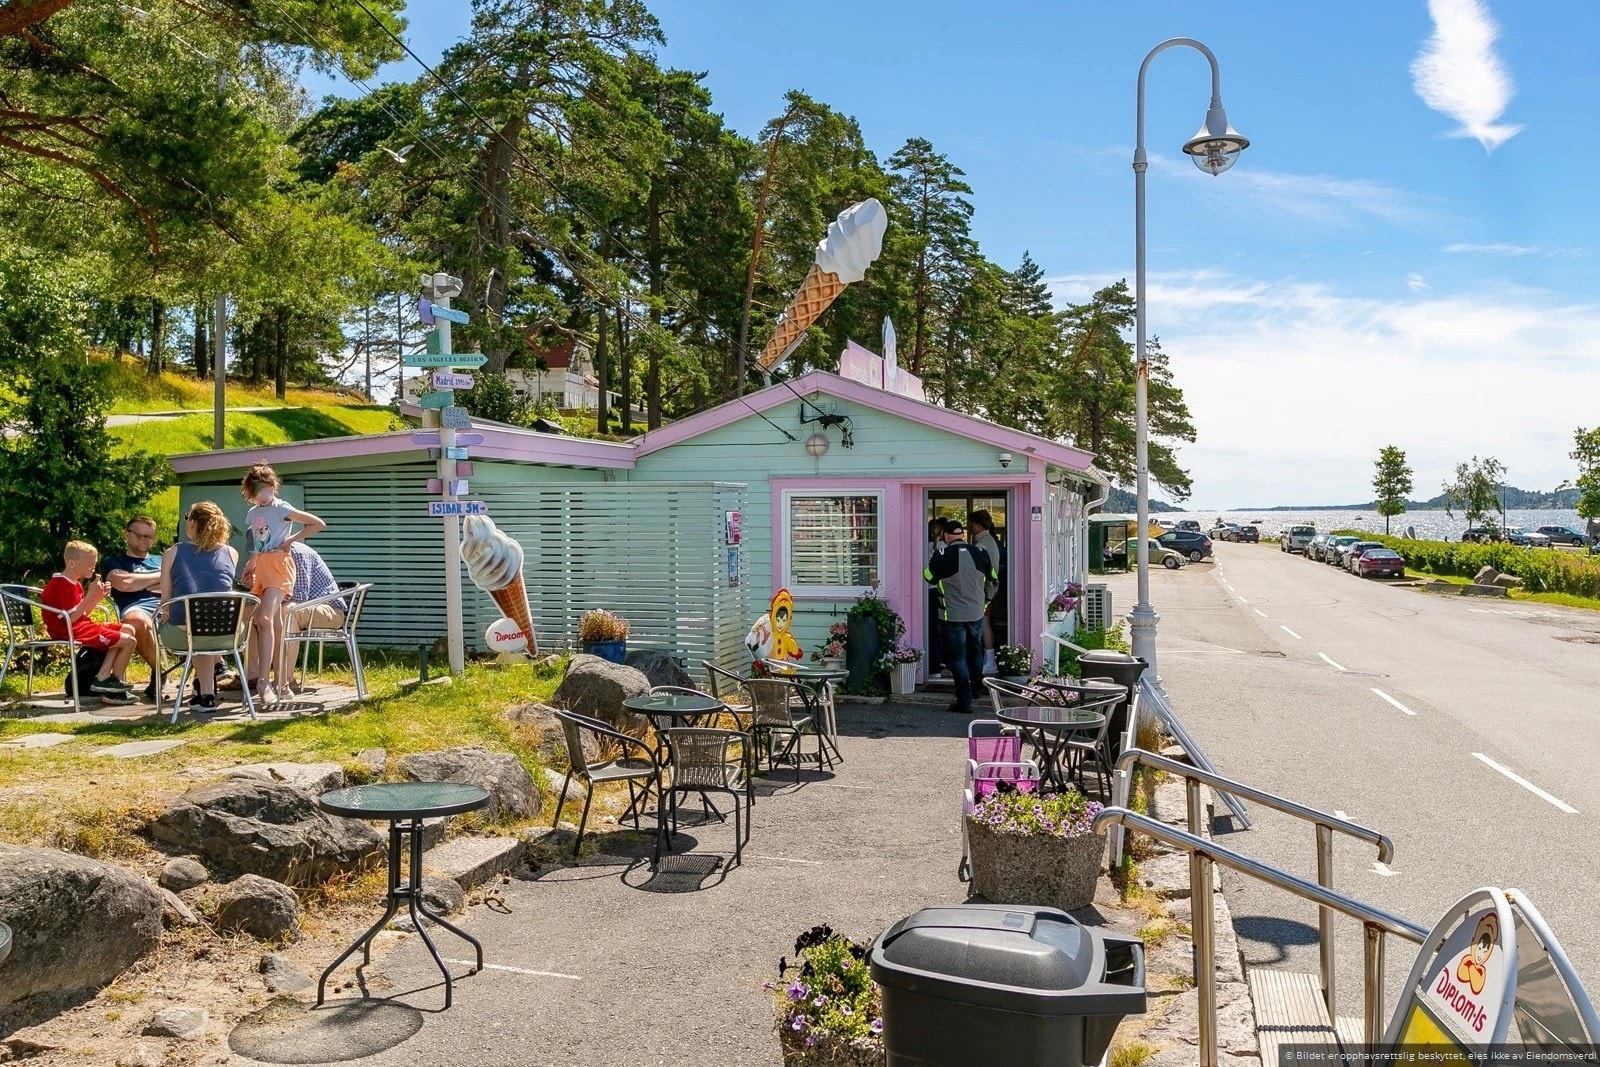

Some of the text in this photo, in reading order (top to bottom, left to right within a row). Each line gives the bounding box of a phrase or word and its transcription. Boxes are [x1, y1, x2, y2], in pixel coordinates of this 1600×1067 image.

[436, 375, 454, 386] Madrid
[445, 407, 465, 418] IBIZA
[432, 503, 462, 515] ISIBAR
